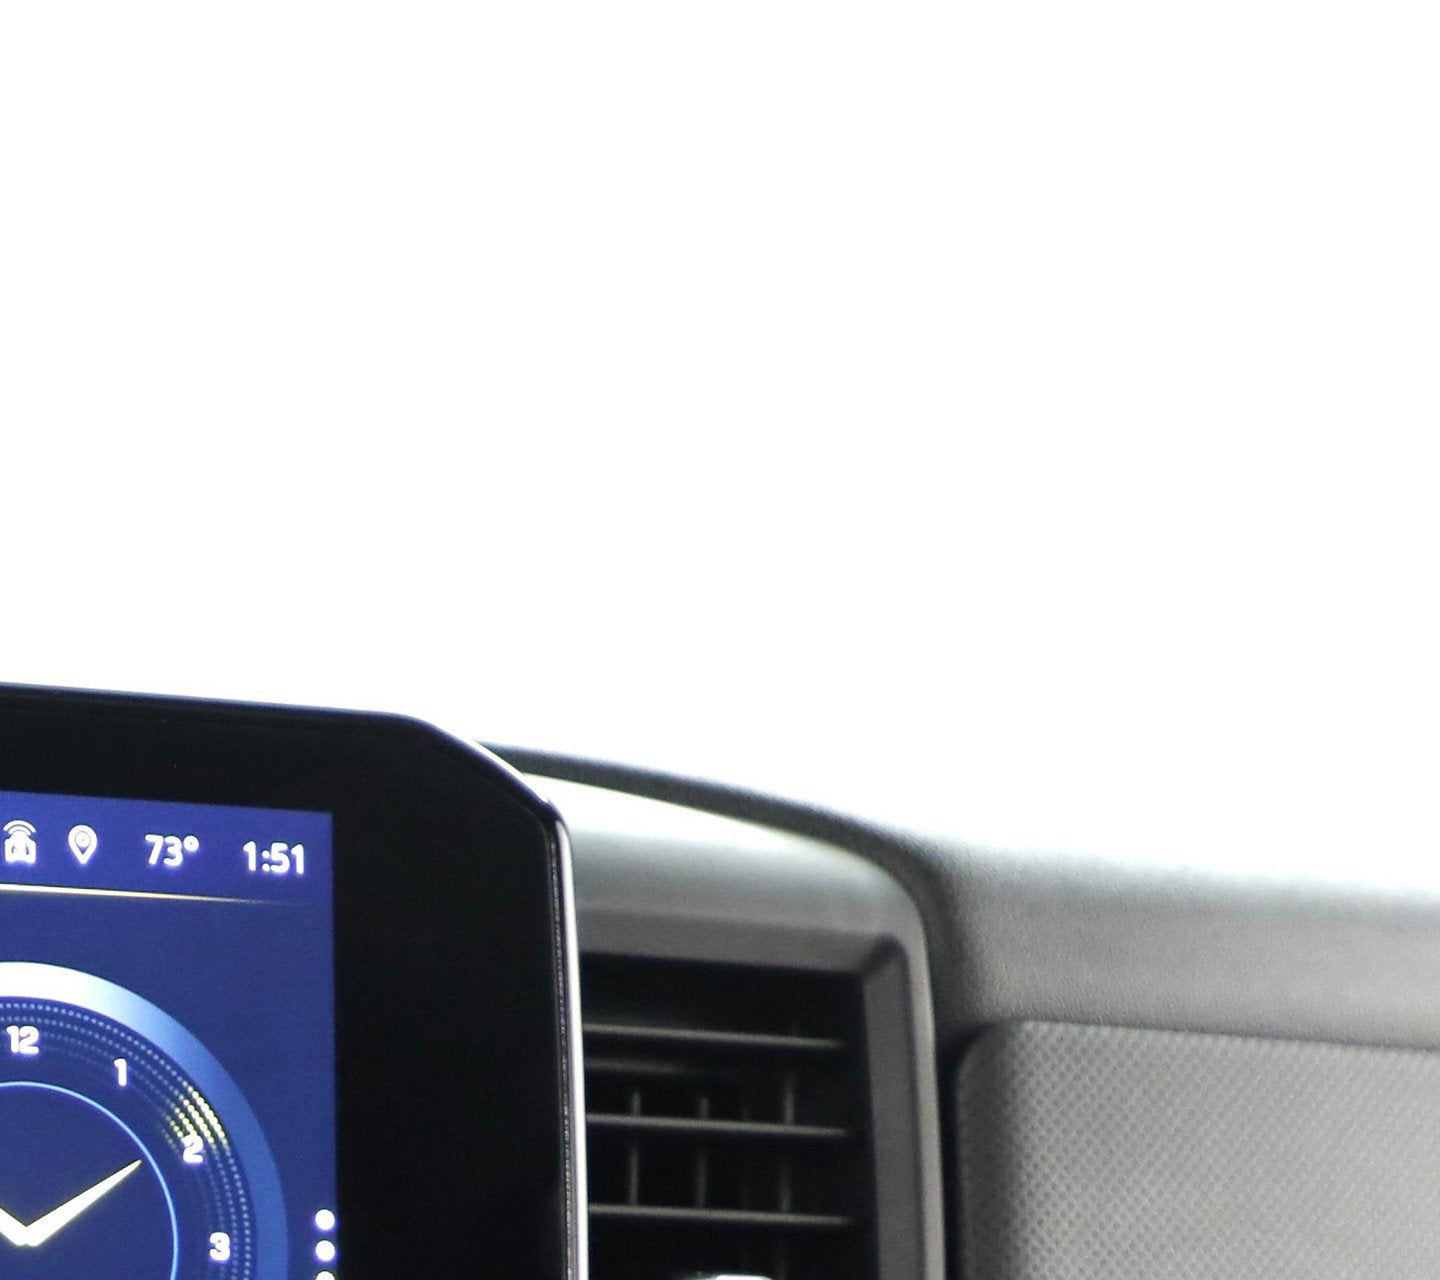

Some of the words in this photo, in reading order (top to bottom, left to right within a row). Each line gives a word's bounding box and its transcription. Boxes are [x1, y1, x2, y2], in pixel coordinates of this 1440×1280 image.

[242, 840, 305, 875] 1:51
[6, 1025, 40, 1056] 12
[113, 1058, 128, 1088] 1
[182, 1134, 205, 1164] 2
[209, 1231, 231, 1263] 3
